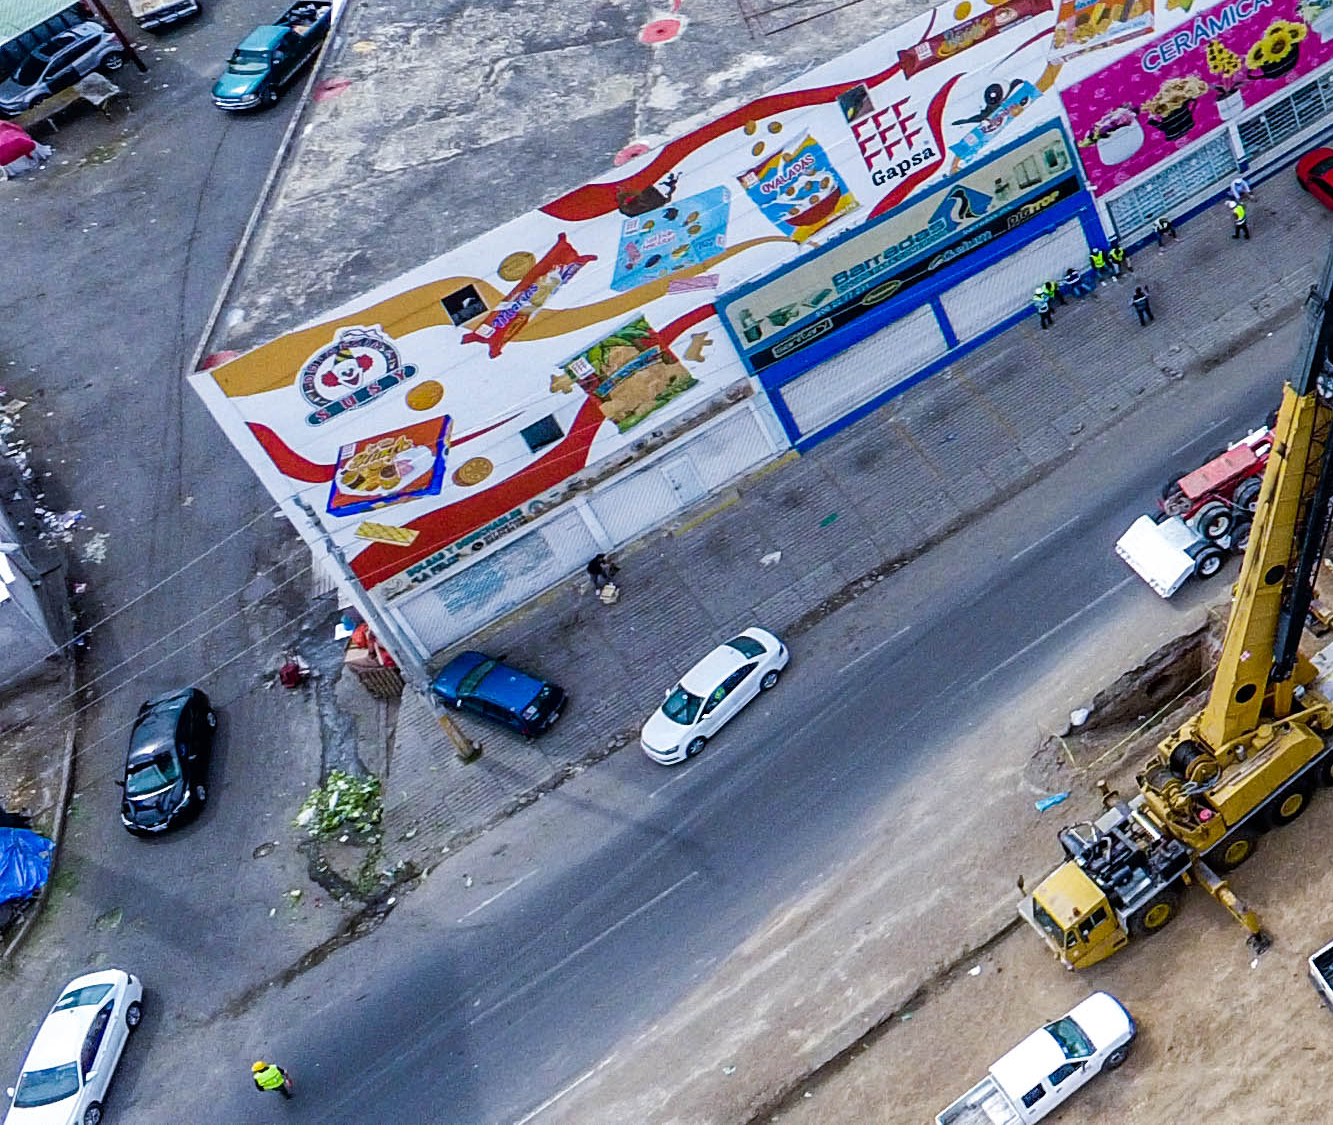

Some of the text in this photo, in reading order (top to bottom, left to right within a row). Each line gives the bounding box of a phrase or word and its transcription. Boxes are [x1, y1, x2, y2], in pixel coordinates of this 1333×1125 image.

[760, 154, 816, 194] OVALADAS
[871, 146, 936, 187] Gapsa
[832, 216, 948, 288] Barradas
[314, 369, 406, 423] SUSY
